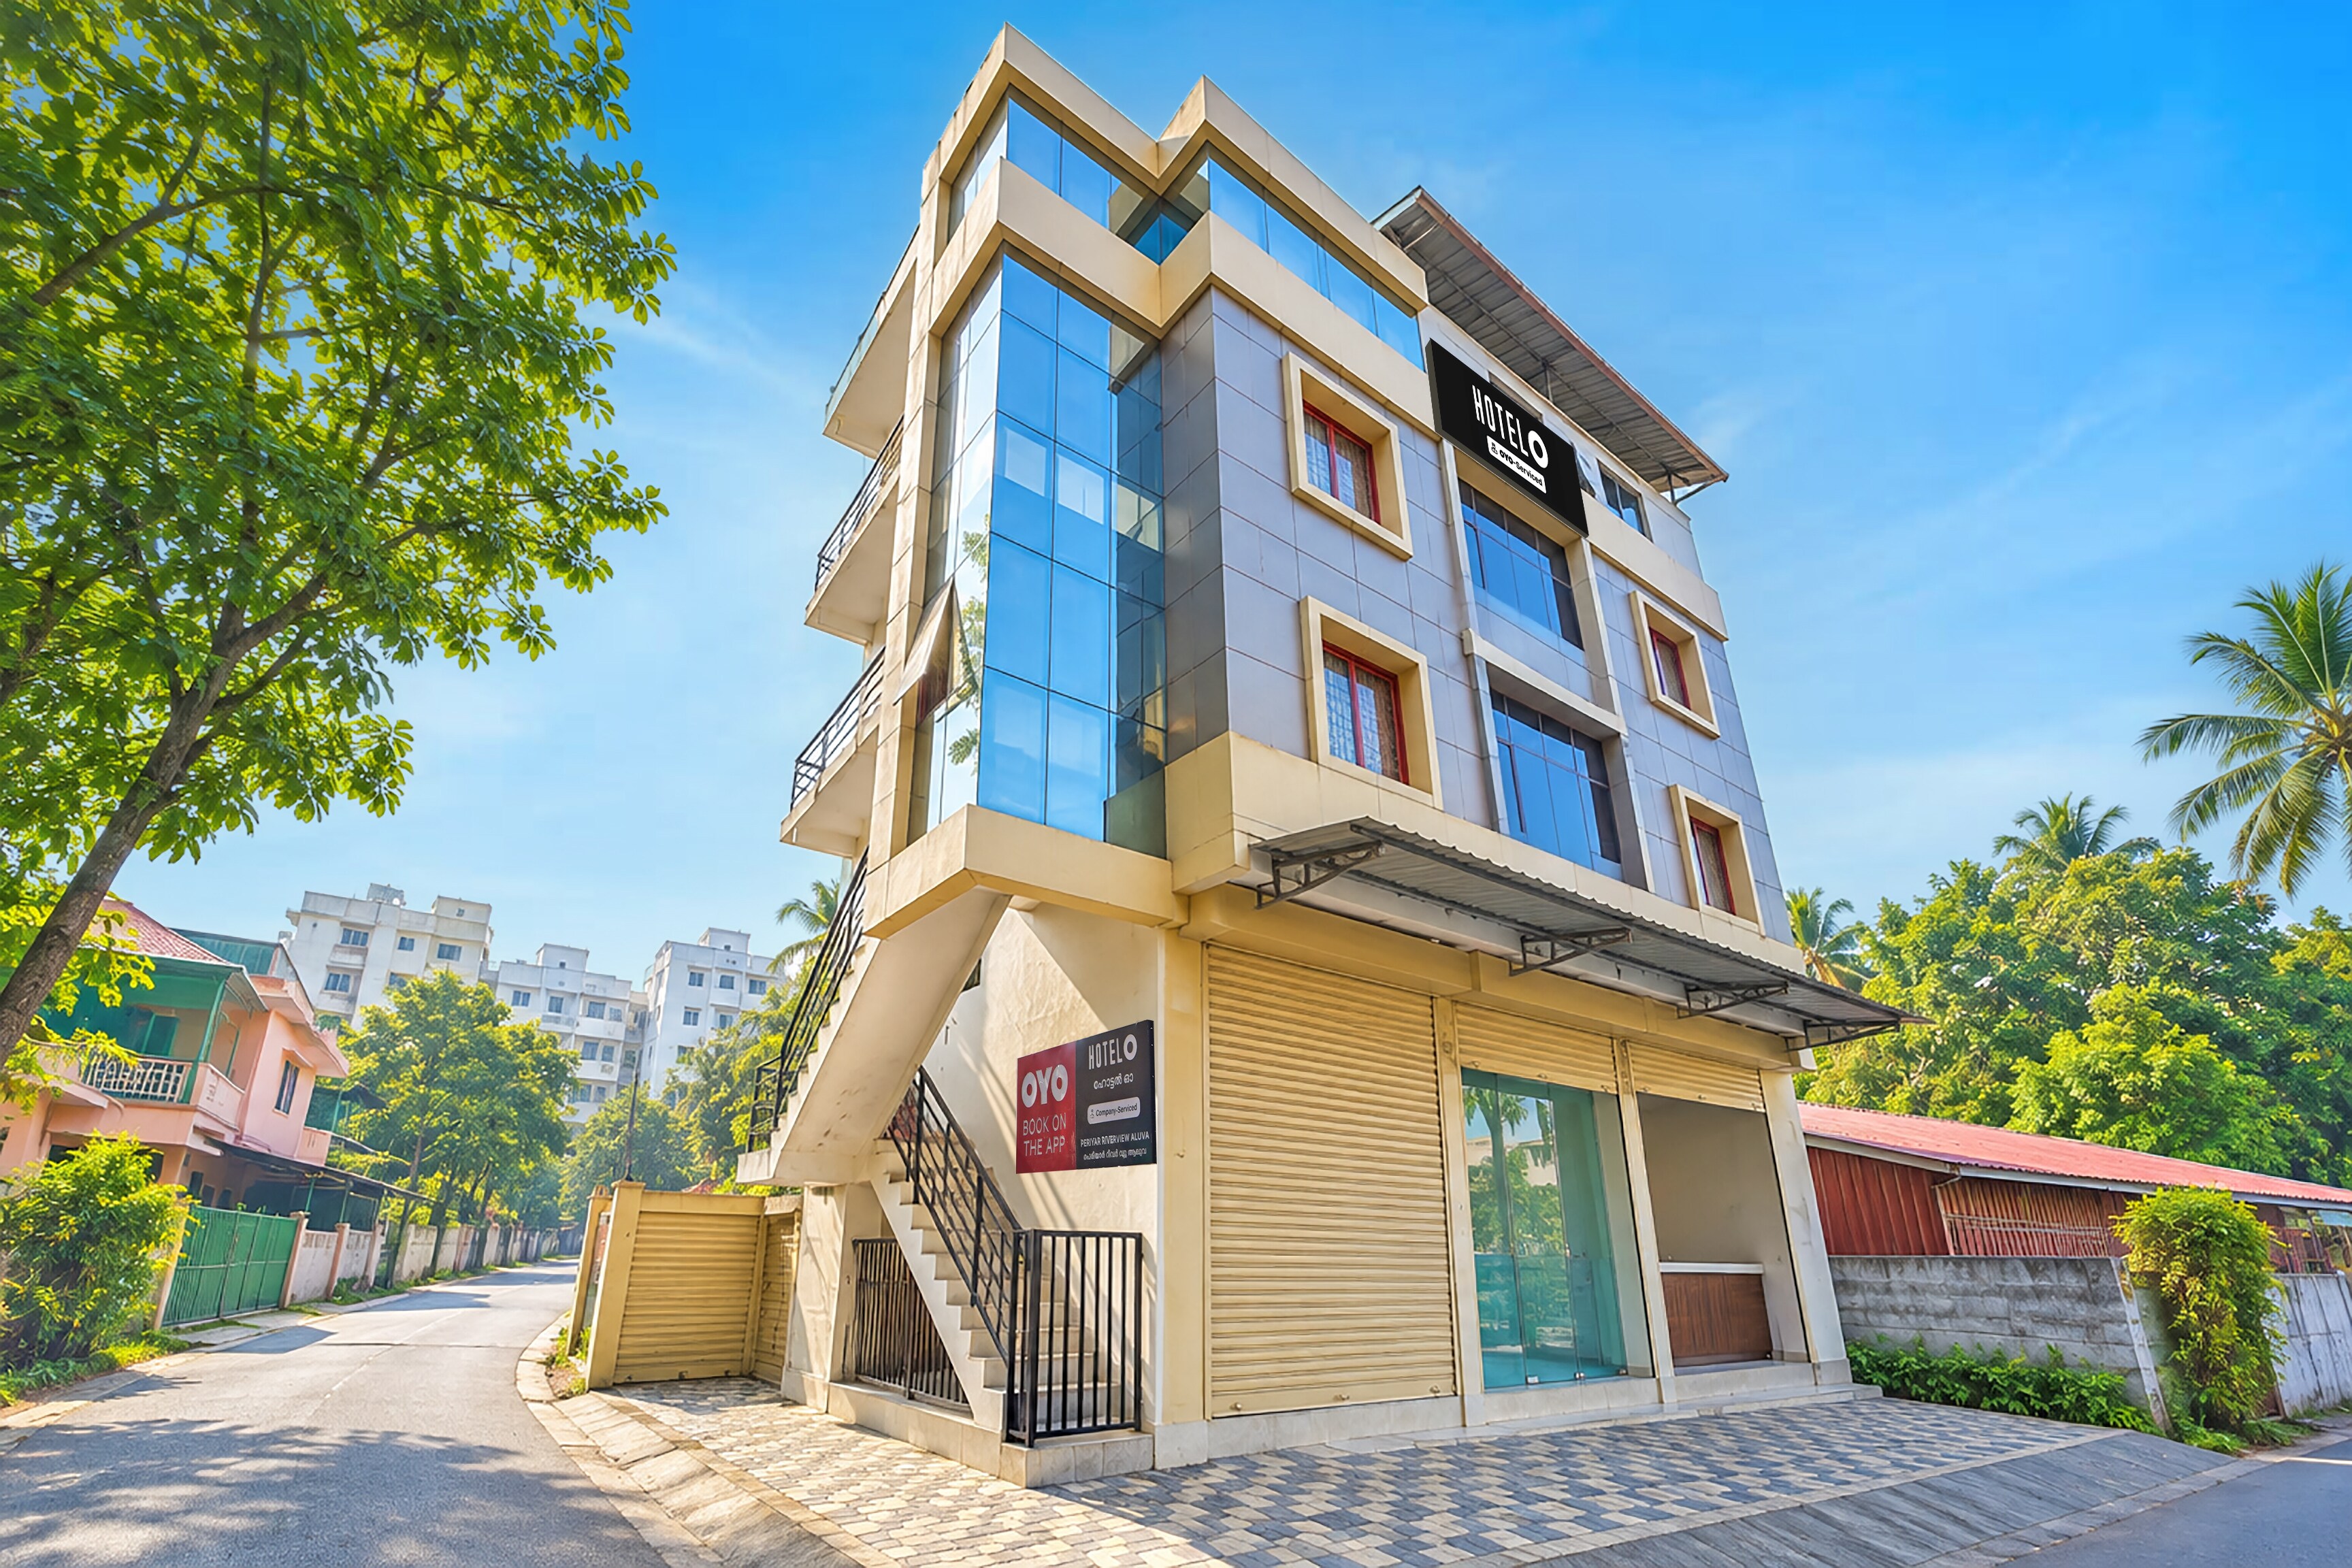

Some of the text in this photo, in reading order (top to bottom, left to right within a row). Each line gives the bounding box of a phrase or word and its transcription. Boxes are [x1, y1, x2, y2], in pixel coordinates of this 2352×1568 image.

[1499, 449, 1543, 486] OYO-Serviced
[1022, 1064, 1068, 1108] OYO
[1094, 1073, 1122, 1090] ഹോട്ടൽ
[1095, 1103, 1137, 1117] Company-Serviced
[1023, 1113, 1066, 1136] BOOK ON
[1024, 1135, 1066, 1156] THE APP
[1080, 1131, 1150, 1147] PERIYAR RIVERVIEW ALUVA
